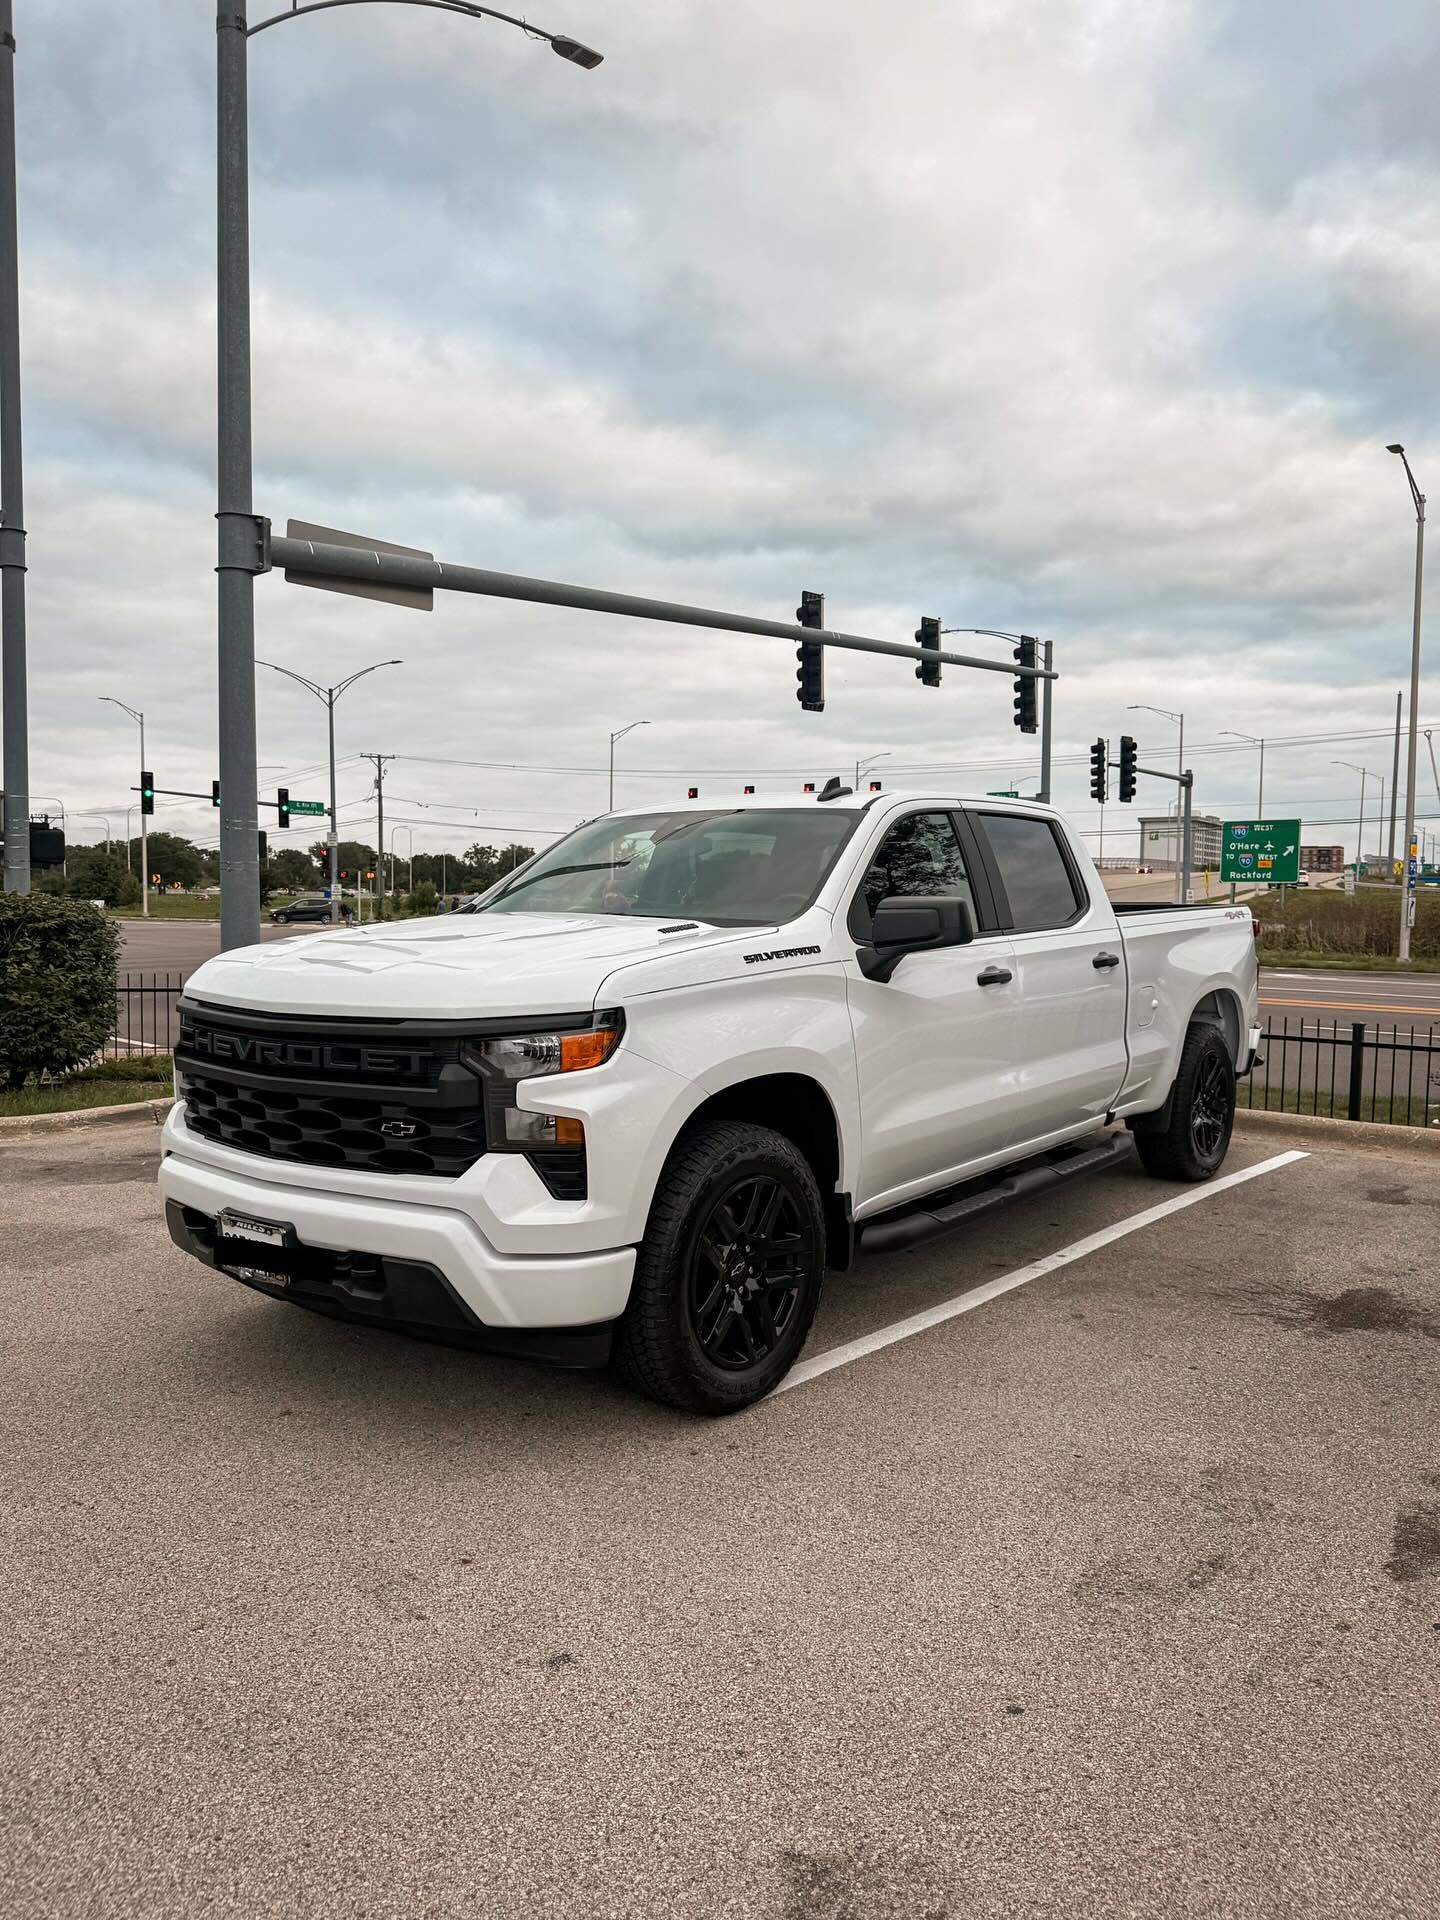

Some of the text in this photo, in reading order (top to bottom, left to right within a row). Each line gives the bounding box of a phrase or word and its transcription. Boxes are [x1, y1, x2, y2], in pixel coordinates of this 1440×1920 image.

[1234, 828, 1246, 836] 190
[1253, 824, 1274, 832] WEST
[1229, 842, 1260, 850] O'Hare
[1257, 853, 1278, 861] WEST
[1229, 871, 1272, 879] Rockford
[743, 945, 821, 964] SILVERADO
[181, 1025, 434, 1074] CHEVROLET
